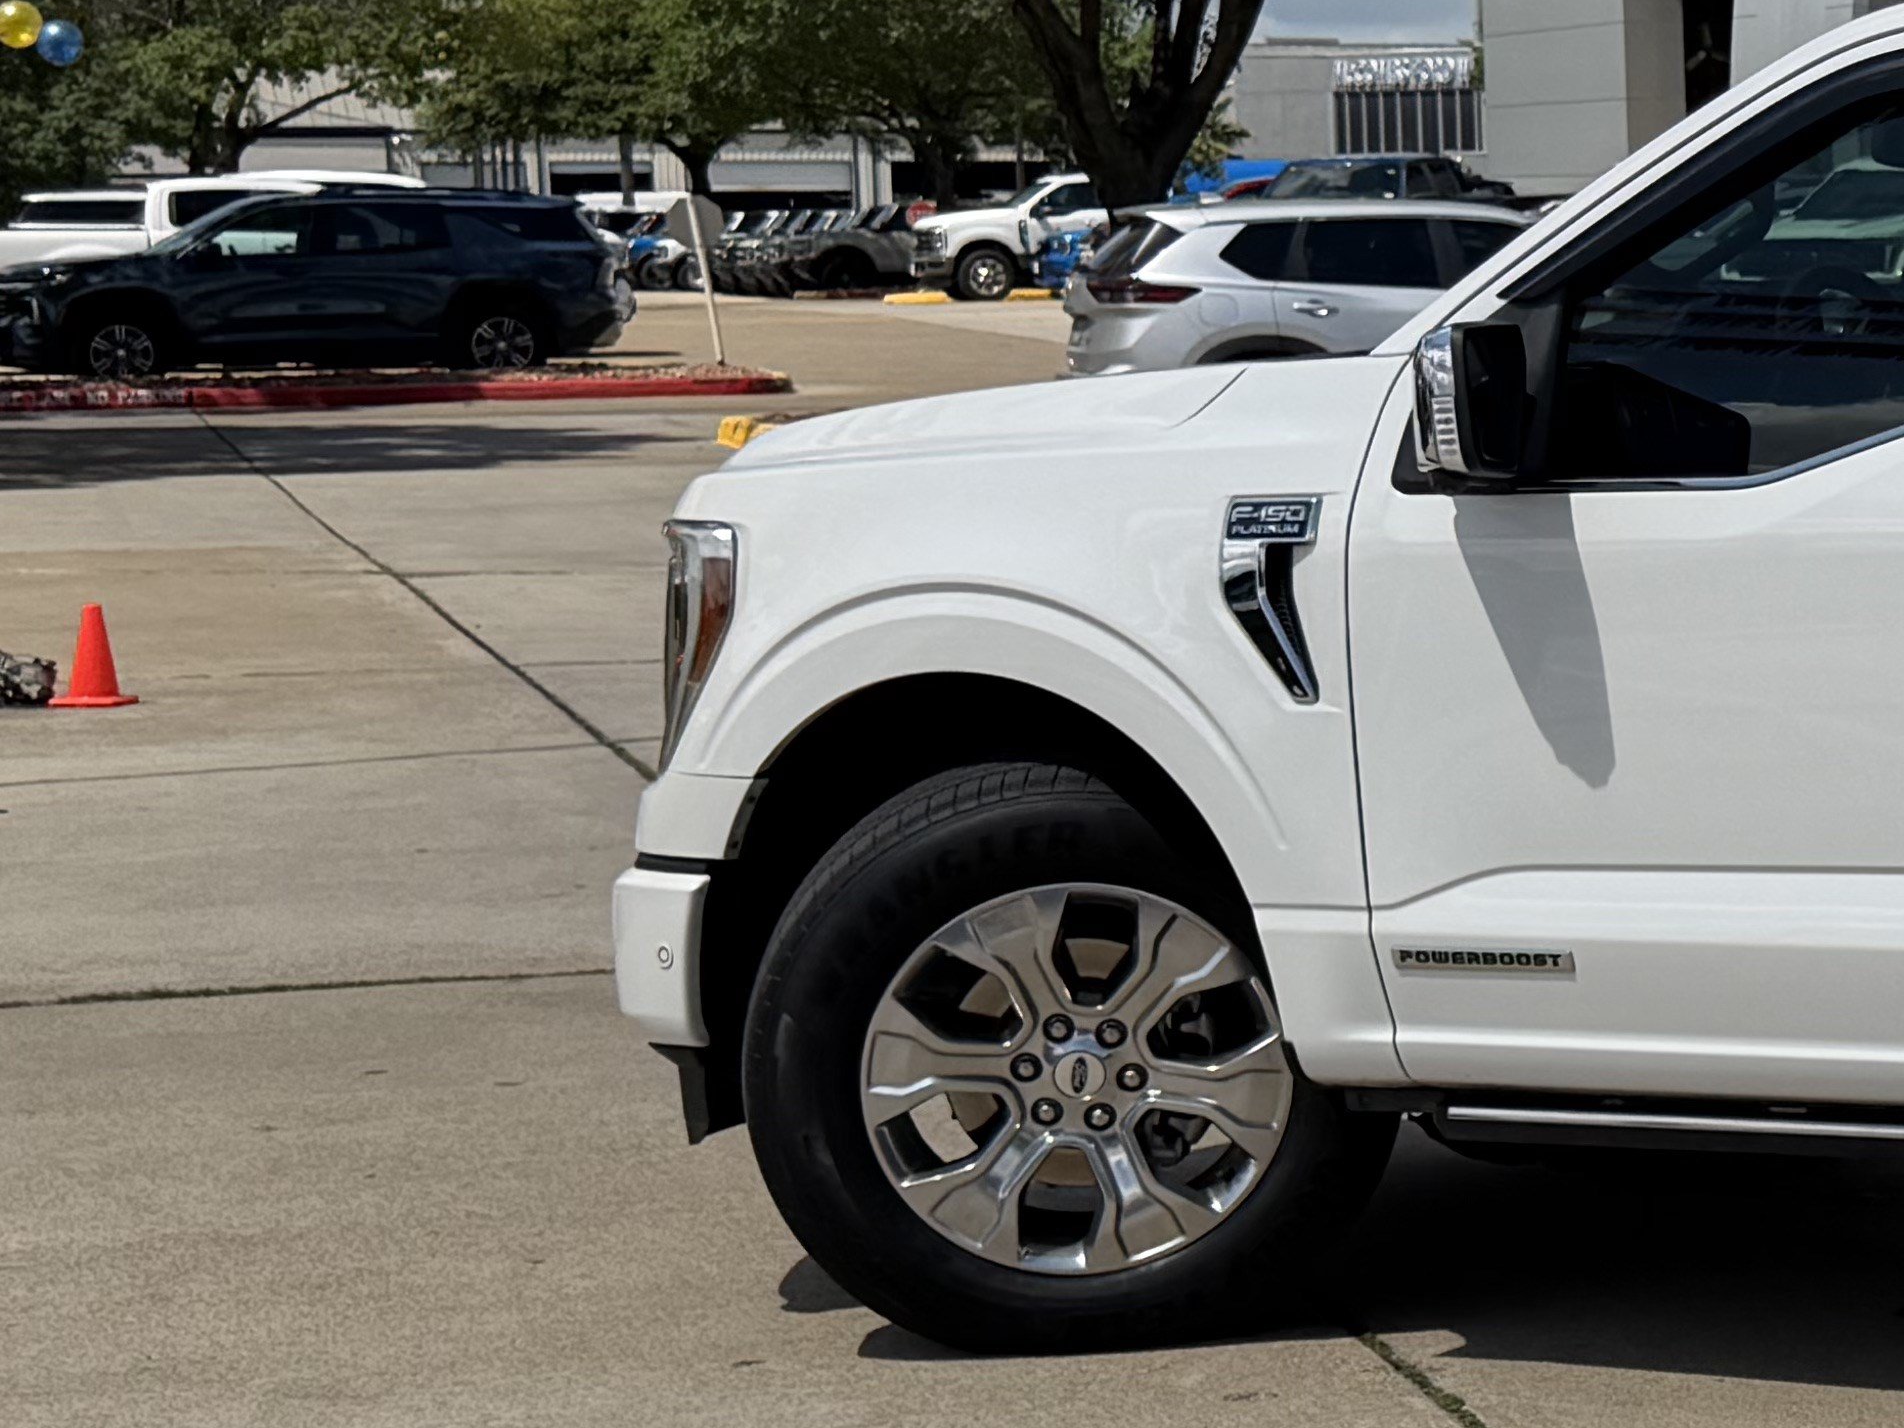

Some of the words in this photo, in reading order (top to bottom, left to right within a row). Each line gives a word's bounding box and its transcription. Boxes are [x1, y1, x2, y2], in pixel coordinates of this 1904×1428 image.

[1230, 504, 1305, 522] F-150
[1231, 523, 1300, 535] PLATINUM
[1398, 949, 1563, 968] POWERBOOST
